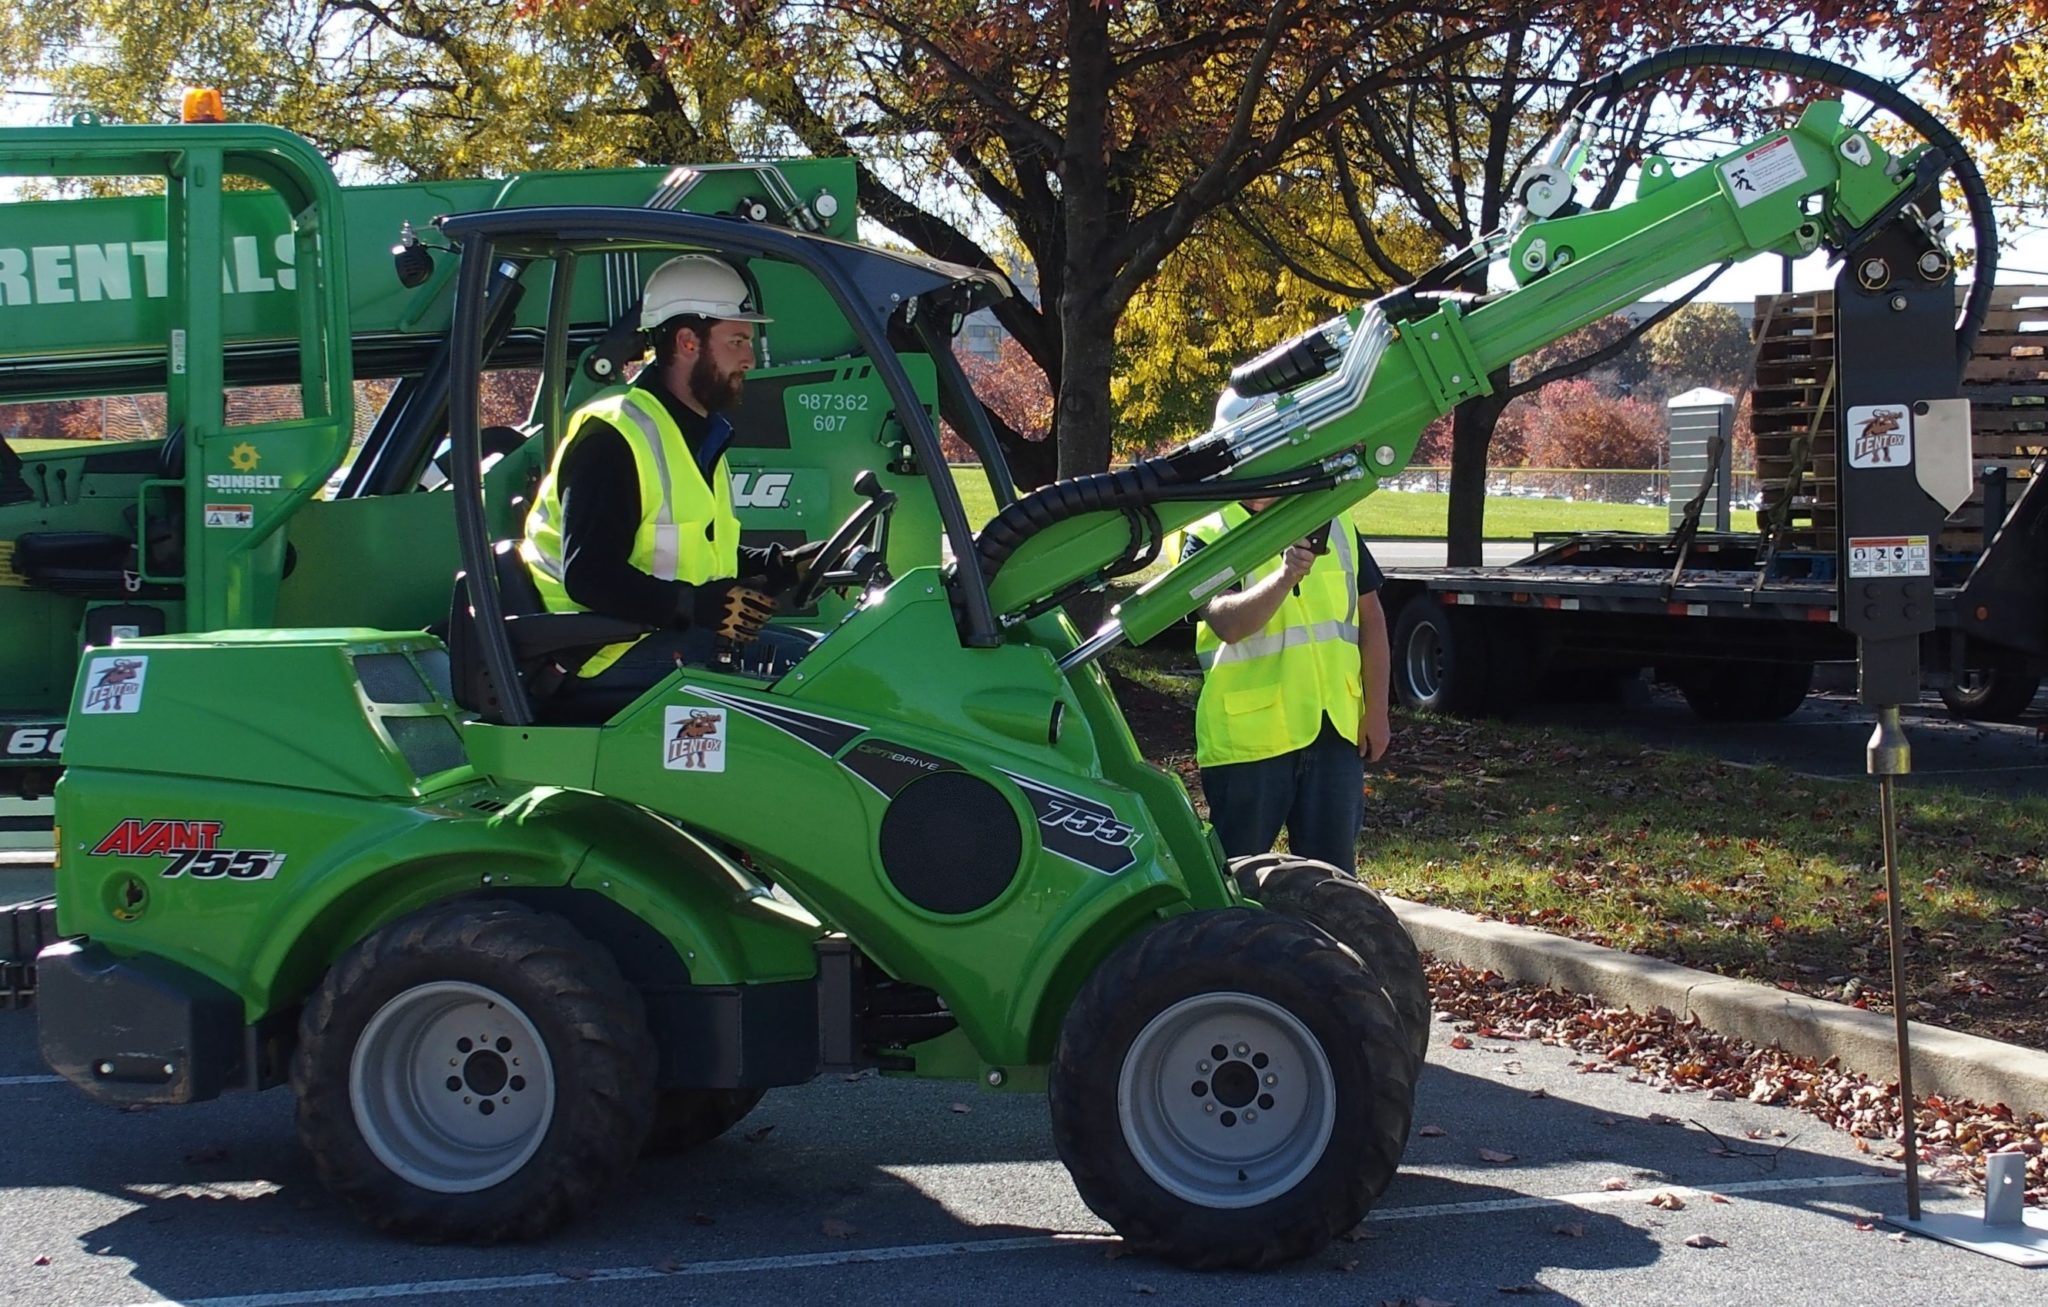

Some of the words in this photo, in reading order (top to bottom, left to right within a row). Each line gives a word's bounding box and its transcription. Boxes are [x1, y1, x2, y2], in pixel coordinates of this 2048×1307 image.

[798, 393, 869, 411] 987362
[813, 415, 847, 432] 607
[207, 475, 282, 488] SUNBELT
[730, 473, 793, 508] LG
[88, 818, 223, 856] AVANT
[160, 849, 287, 881] 755i
